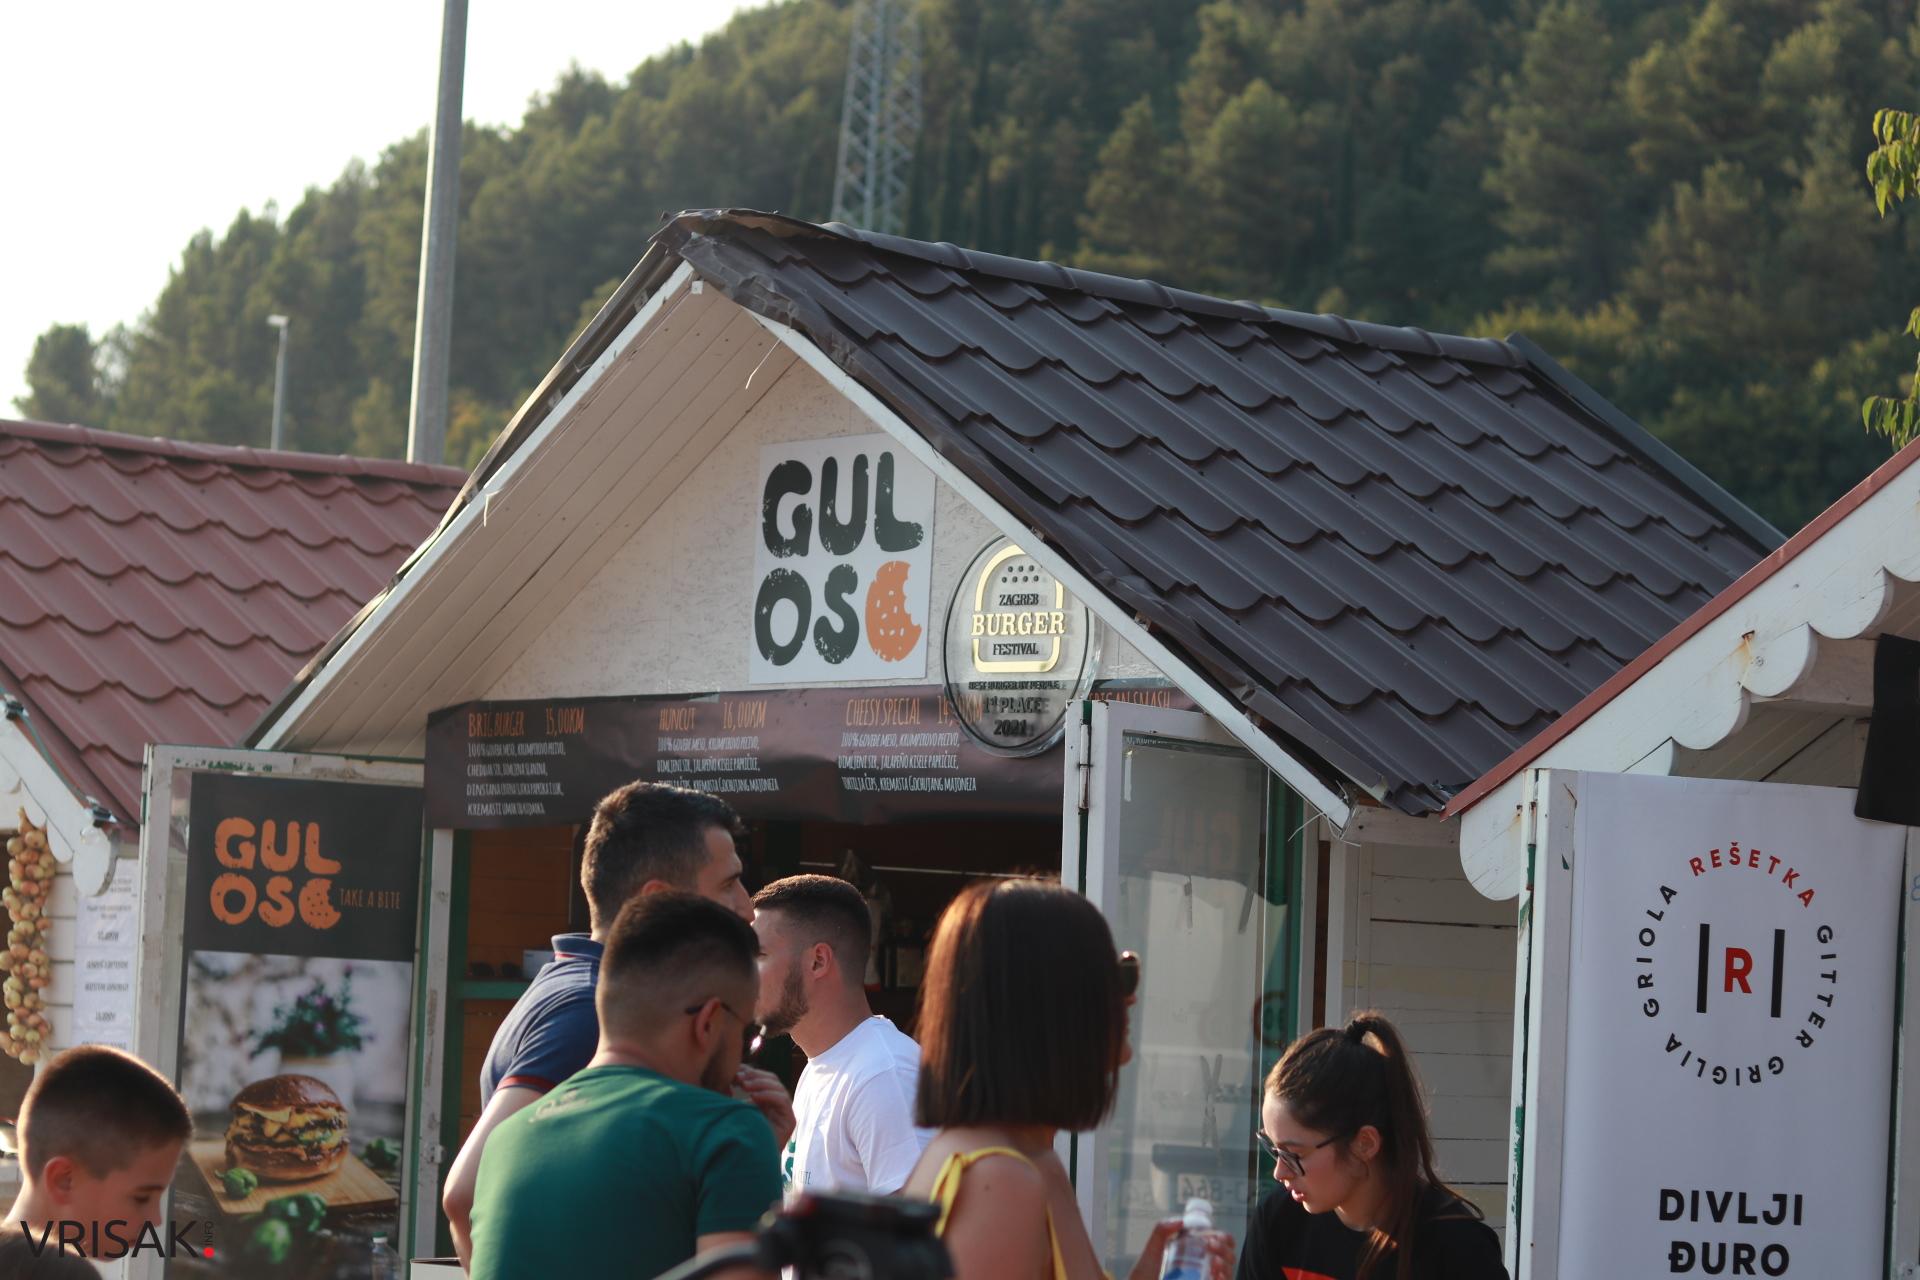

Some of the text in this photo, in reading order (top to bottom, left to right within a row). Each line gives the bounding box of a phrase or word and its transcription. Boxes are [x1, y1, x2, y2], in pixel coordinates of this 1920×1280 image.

[762, 451, 924, 558] GUL
[999, 593, 1039, 606] ZAGREB
[971, 611, 1066, 636] BURGER
[993, 642, 1039, 656] FESTIVAL
[658, 700, 768, 731] HUNCUT 16,00KM
[846, 697, 881, 726] CHEESY
[881, 697, 921, 726] SPECIAL
[1000, 697, 1042, 713] PLACE
[841, 732, 859, 747] 100%
[881, 733, 898, 747] MESO,
[899, 732, 937, 747] KRUMPIROVO
[937, 731, 959, 747] PECIVO,
[994, 719, 1027, 736] 2021
[909, 754, 928, 769] KISELE
[879, 776, 908, 791] KREMASTA
[944, 776, 977, 793] MAJONEZA
[215, 816, 341, 875] GUL
[1689, 841, 1816, 908] REŠETKA
[339, 887, 401, 909] TAKE A BITE
[1636, 883, 1678, 1018] GRIOLA
[1795, 924, 1838, 1049] GITTER
[1664, 1032, 1785, 1087] GRIGLIA
[1658, 1188, 1804, 1226] DIVLJI
[1668, 1240, 1790, 1277] ĐURO
